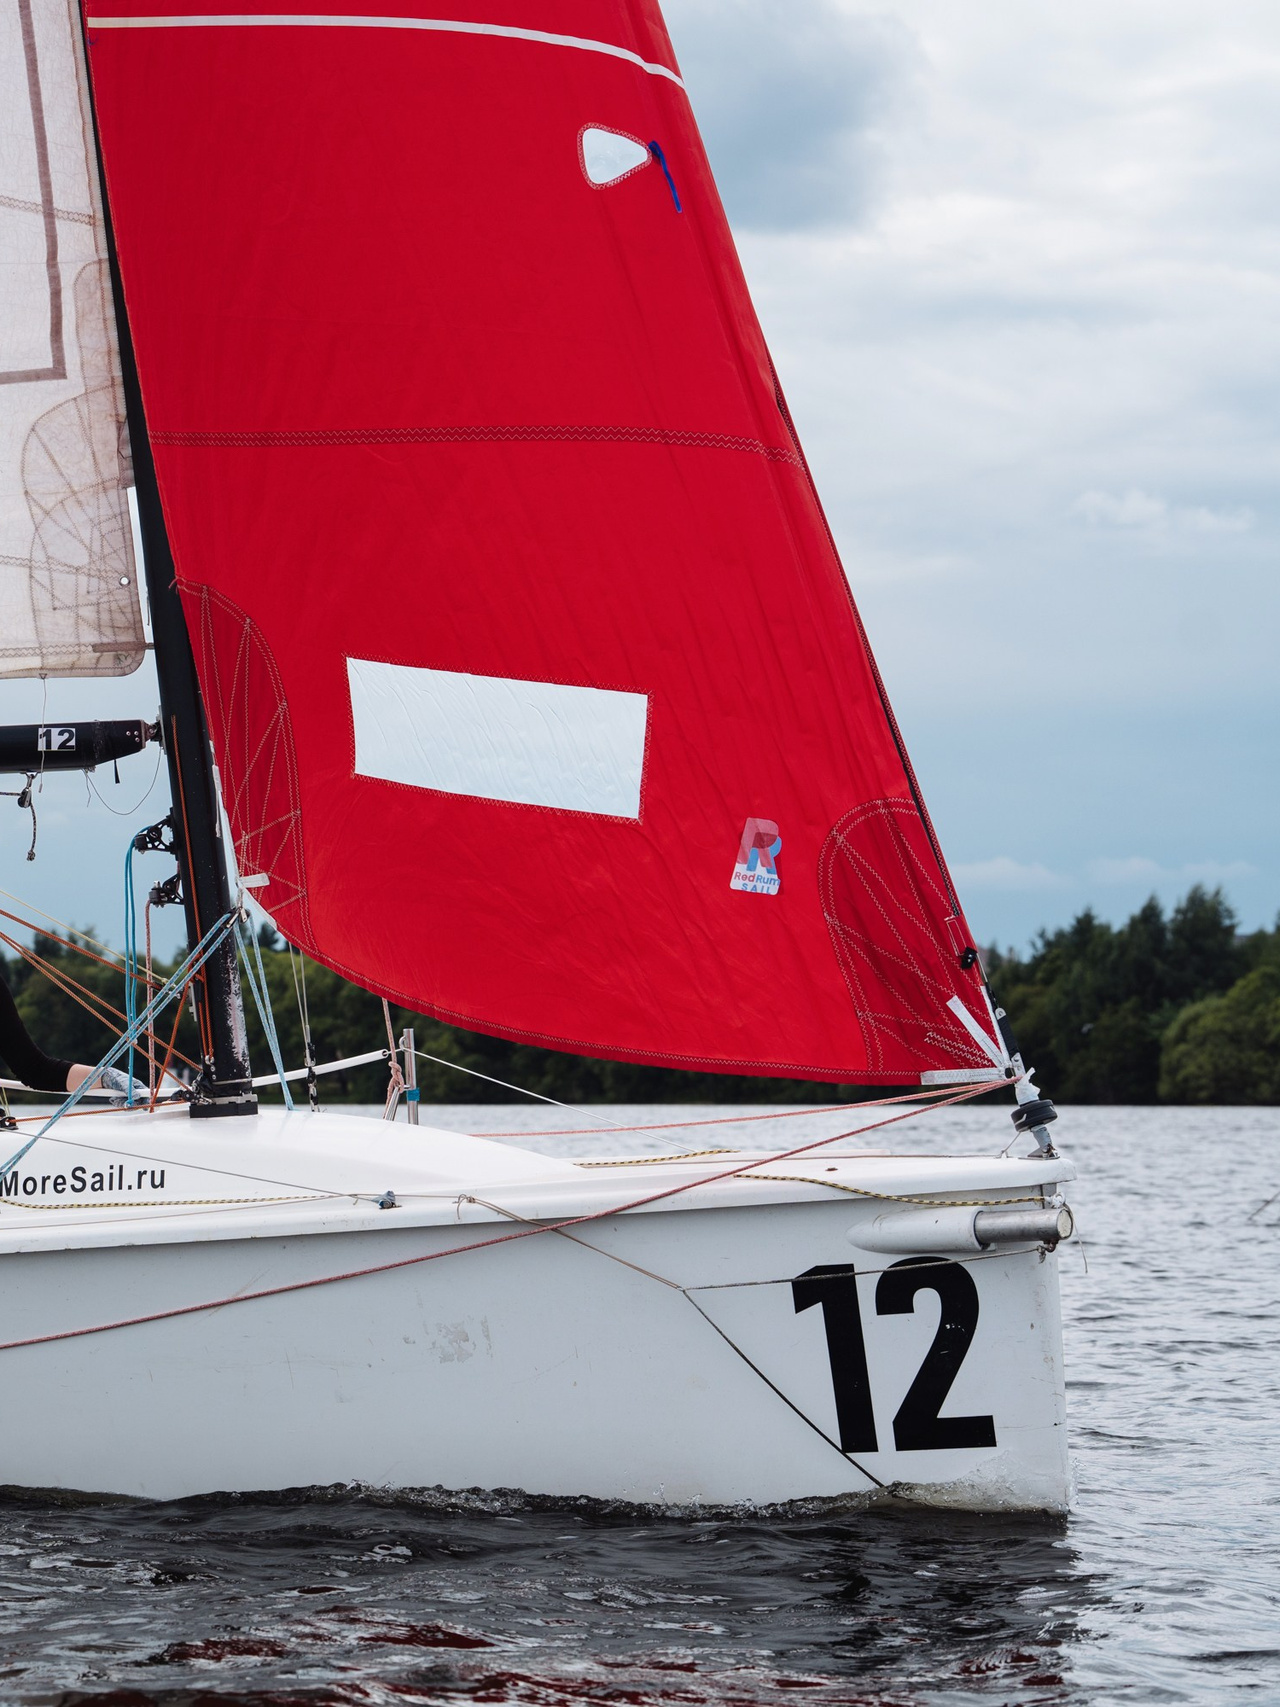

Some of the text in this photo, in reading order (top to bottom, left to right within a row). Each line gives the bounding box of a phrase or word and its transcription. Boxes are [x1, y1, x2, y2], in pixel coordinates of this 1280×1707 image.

[39, 728, 75, 751] 12
[733, 871, 781, 886] RedRum
[741, 882, 772, 895] SAIL
[791, 1256, 998, 1453] 12
